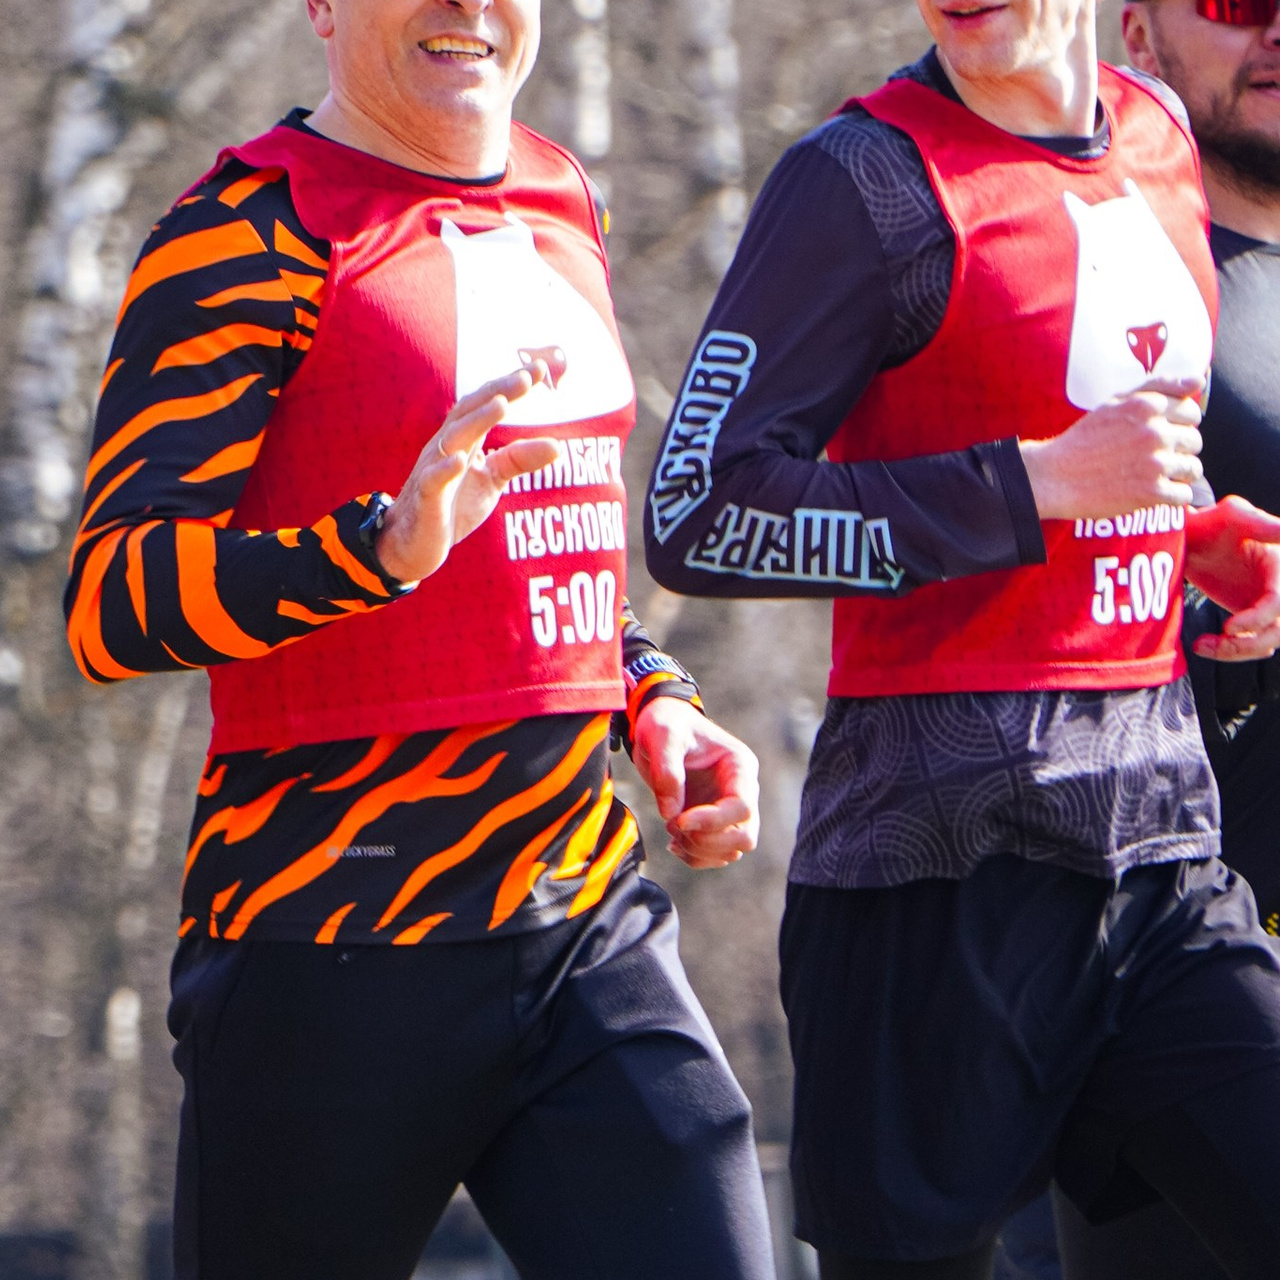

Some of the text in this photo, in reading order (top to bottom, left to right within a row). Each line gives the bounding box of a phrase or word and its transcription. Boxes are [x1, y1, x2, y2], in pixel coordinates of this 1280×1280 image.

[504, 500, 625, 561] КУСКОВО
[528, 569, 616, 648] 5:00
[1091, 550, 1174, 625] 5:00
